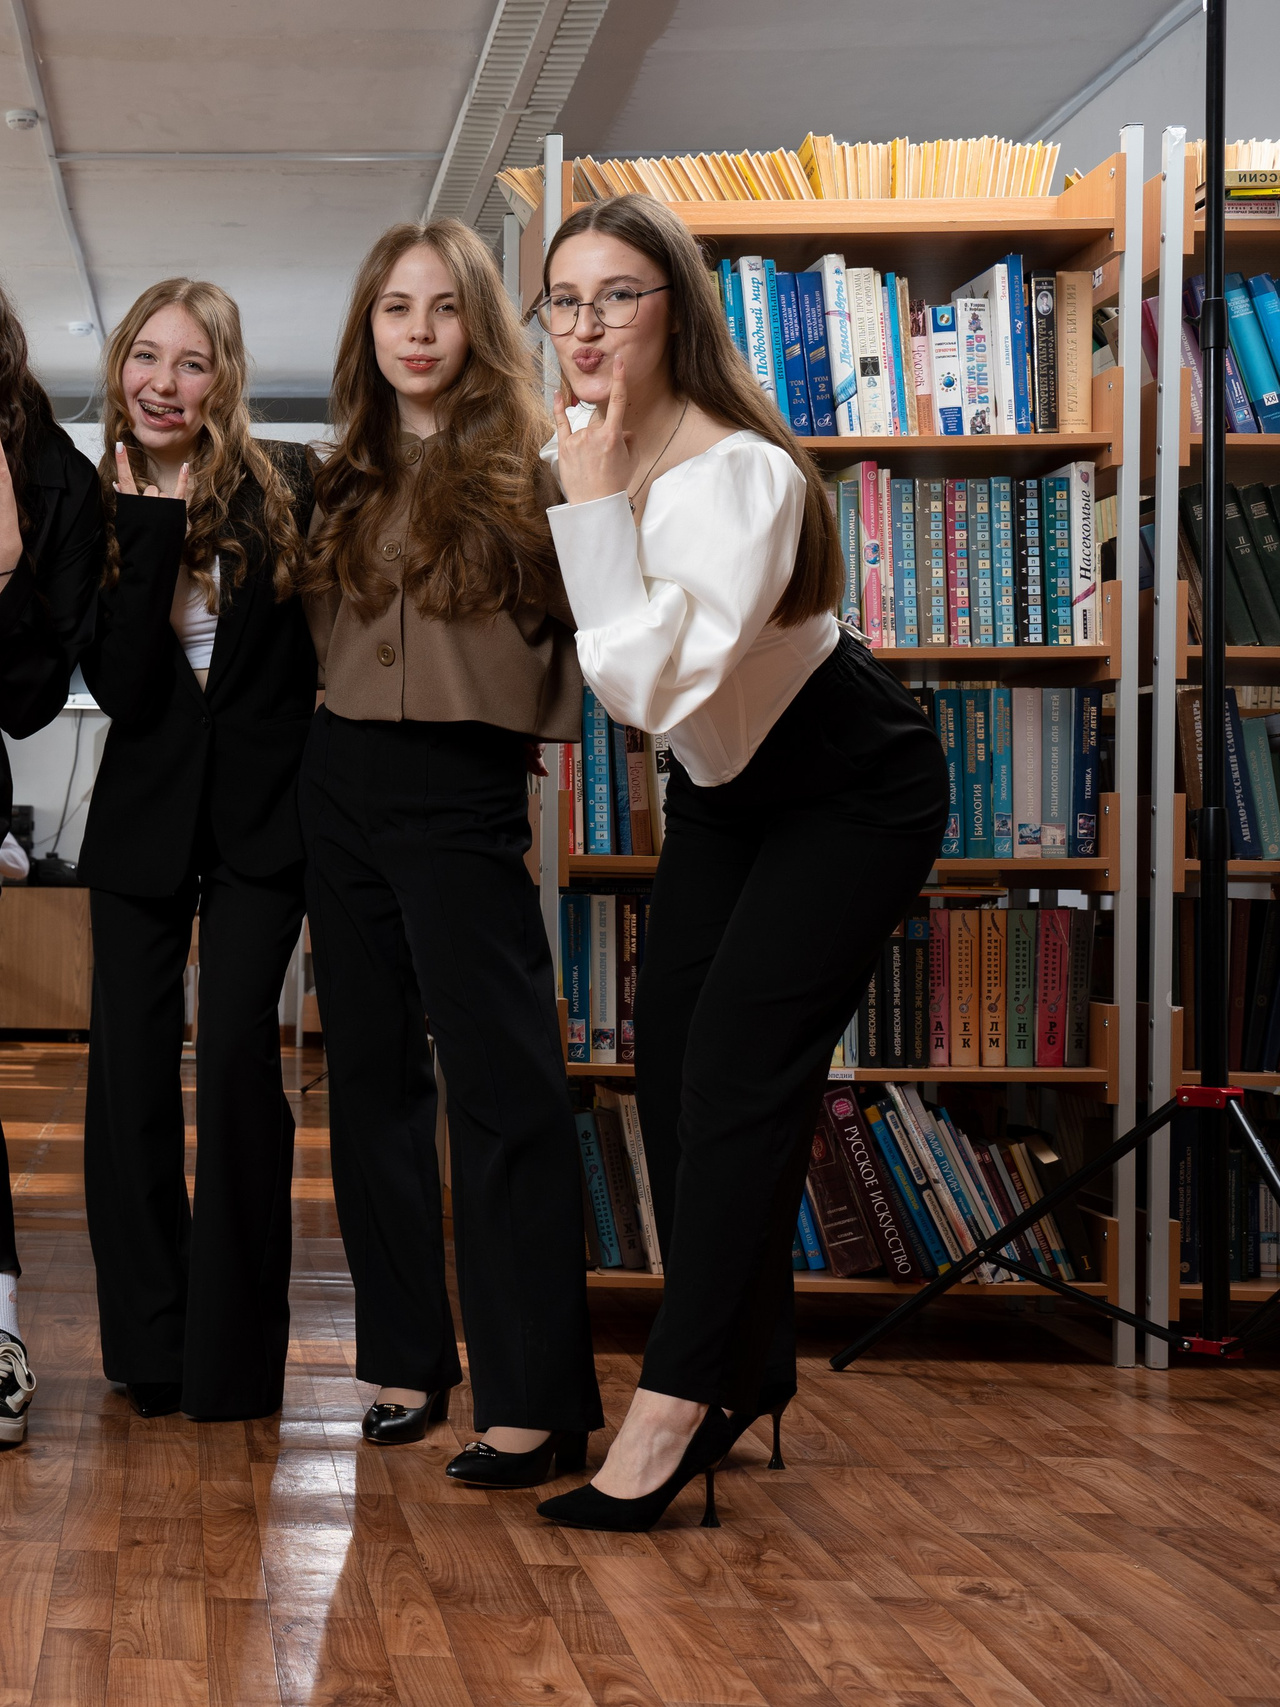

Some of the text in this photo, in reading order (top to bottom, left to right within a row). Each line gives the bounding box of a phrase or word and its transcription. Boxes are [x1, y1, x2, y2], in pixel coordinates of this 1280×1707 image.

[1238, 173, 1280, 183] ССИИ
[863, 272, 873, 306] ФОРМУЛАХ
[1066, 284, 1077, 333] БИБЛИЯ
[752, 277, 769, 376] Подводный мир
[768, 267, 784, 380] ВСЕМИРНАЯ ГЕОГРАФИЯ
[834, 280, 853, 368] Динозавры
[854, 273, 867, 354] ШКОЛЬНАЯ ПРОГРАММА
[795, 387, 801, 396] 1
[819, 383, 826, 392] 2
[966, 335, 977, 405] КНИГА ЗАГАДОК
[974, 334, 989, 404] БОЛЬШАЯ
[1038, 318, 1049, 425] ИСТОРИЯ КУЛЬТУРЫ
[1066, 339, 1079, 413] КУЛИНАРНАЯ
[1079, 490, 1092, 582] Насекомые
[1238, 536, 1246, 544] II
[1264, 535, 1274, 543] III
[850, 554, 858, 603] ДОМАШНИЕ
[894, 484, 906, 644] ХИМИЯ
[924, 483, 932, 643] ИСТОРИЯ
[948, 482, 958, 645] ЛИТЕРАТУРА
[970, 484, 980, 643] ФИЗИКА
[993, 483, 1003, 644] ГЕОГРАФИЯ
[1019, 481, 1029, 642] МАТЕМАТИКА
[1048, 481, 1060, 644] РУССКИЙ ЯЗЫК
[977, 712, 985, 740] ДЕТЕЙ
[1051, 695, 1059, 722] ДЕТЕЙ
[1051, 725, 1059, 742] ДЛЯ
[630, 762, 642, 803] Человек
[1230, 754, 1251, 843] АНГЛО-РУССКИЙ
[973, 784, 983, 836] БИОЛОГИЯ
[914, 923, 923, 938] 3
[915, 947, 923, 1059] ФИЗИЧЕСКАЯ ЭНЦИКЛОПЕДИЯ
[934, 1021, 943, 1031] А
[963, 1022, 970, 1031] Е
[989, 1021, 999, 1032] Л
[1048, 1022, 1057, 1031] Р
[868, 1009, 876, 1056] ФИЗИЧЕСКАЯ
[893, 1008, 901, 1056] ФИЗИЧЕСКАЯ
[934, 1037, 944, 1049] Д
[962, 1038, 970, 1048] К
[988, 1037, 1000, 1048] М
[1016, 1039, 1027, 1049] П
[1017, 1023, 1027, 1033] Н
[1047, 1035, 1056, 1046] С
[1074, 1039, 1083, 1049] Я
[1075, 1023, 1084, 1033] Х
[915, 1105, 944, 1157] ВЛАДИМИР
[940, 1160, 960, 1193] ПУТИН
[844, 1125, 879, 1188] РУССКОЕ
[869, 1190, 912, 1274] ИСКУССТВО
